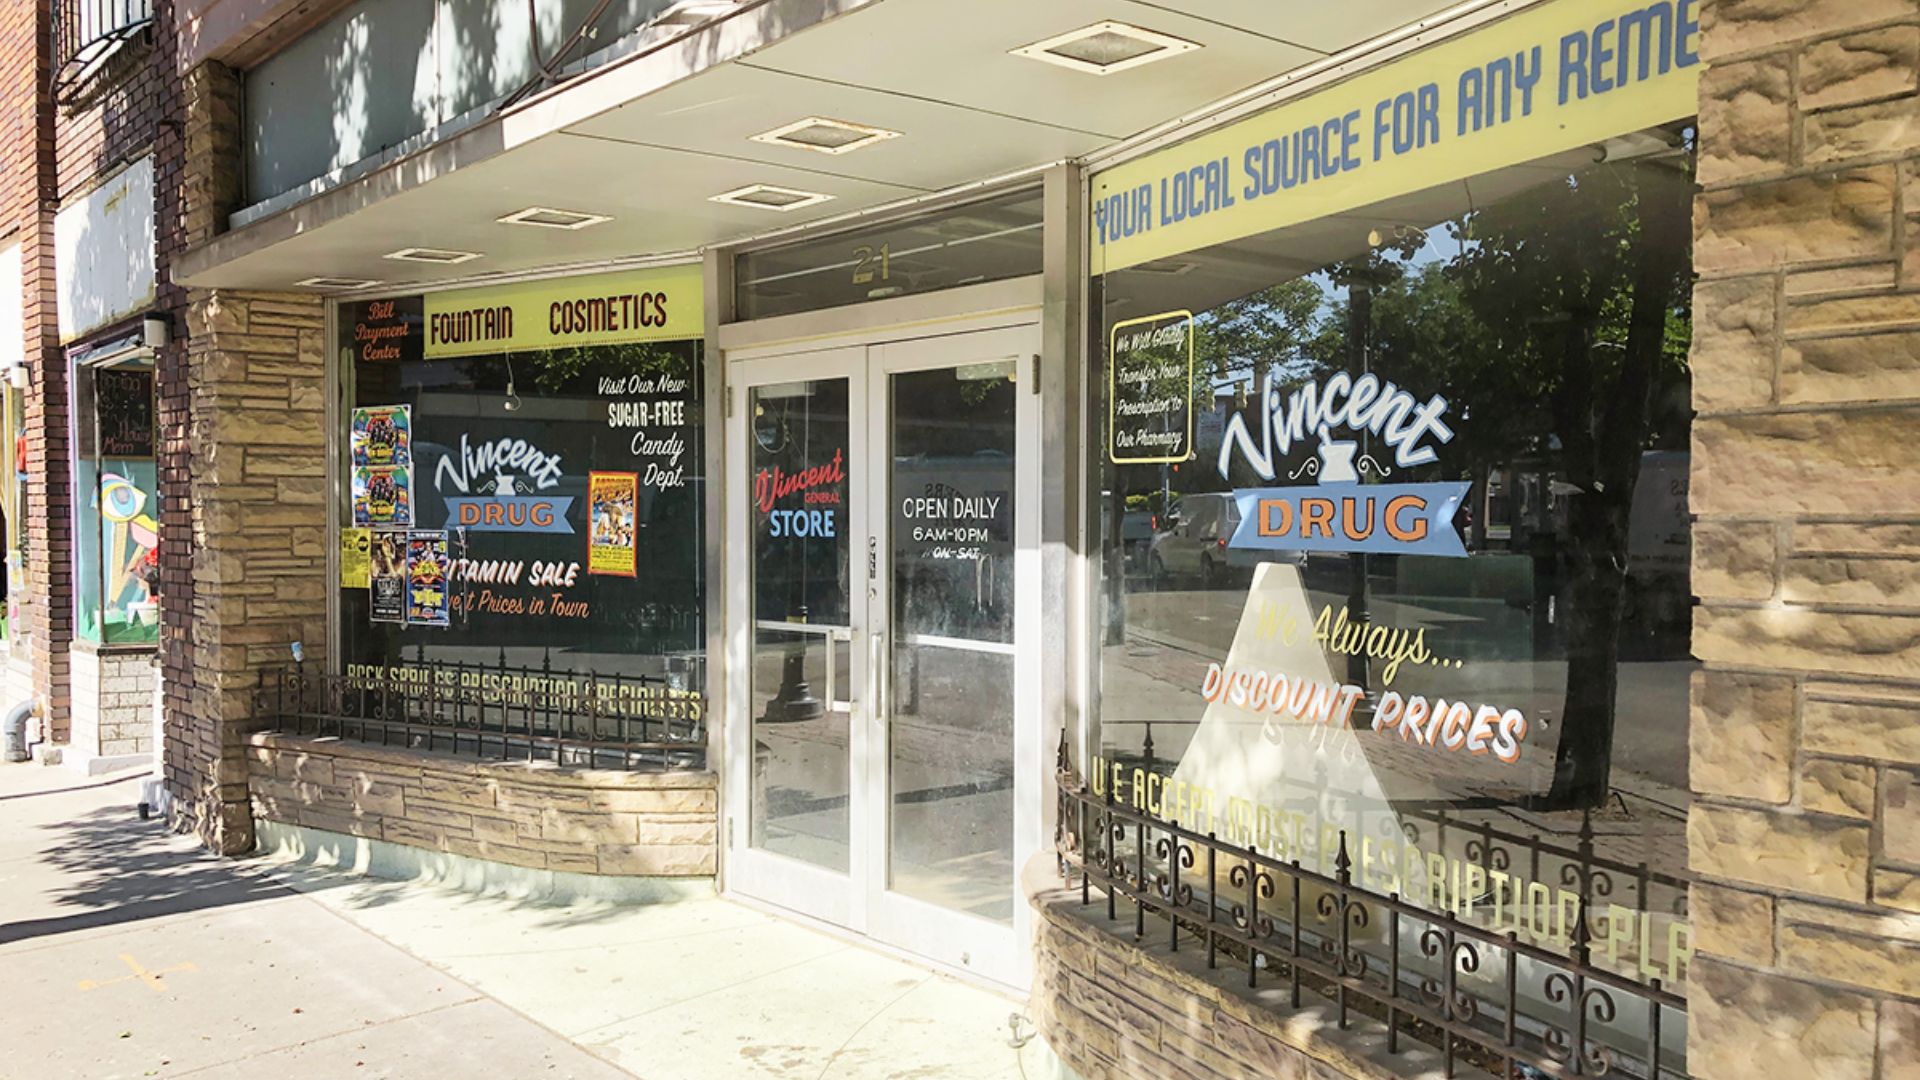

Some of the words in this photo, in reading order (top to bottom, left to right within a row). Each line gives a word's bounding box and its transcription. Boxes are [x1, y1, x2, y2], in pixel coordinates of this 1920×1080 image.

[1094, 184, 1152, 246] YOUR
[1160, 155, 1235, 227] LOCAL
[1243, 109, 1361, 200] SOURCE
[1373, 82, 1440, 161] FOR
[1457, 45, 1541, 137] ANY
[1558, 0, 1700, 106] REME
[852, 243, 890, 284] 21
[367, 301, 396, 320] Bill
[430, 305, 513, 345] FOUNTAIN
[549, 292, 668, 335] COSMETICS
[354, 322, 410, 345] Payment
[362, 342, 401, 360] Center
[598, 376, 627, 395] Visit
[628, 374, 655, 394] Our
[656, 373, 688, 393] New
[608, 400, 685, 428] SUGAR-FREE
[1117, 398, 1171, 419] Prescription
[1217, 369, 1456, 481] Vincent
[631, 430, 685, 467] Candy
[1116, 430, 1134, 448] Our
[1135, 428, 1184, 453] Pharmacy
[434, 432, 564, 494] Vincent
[644, 462, 685, 492] Dept.
[754, 448, 846, 513] Vincent
[458, 502, 555, 526] DRUG
[902, 497, 948, 519] OPEN
[952, 496, 1001, 519] DAILY
[1255, 494, 1430, 543] DRUG
[769, 508, 836, 538] STORE
[921, 545, 982, 560] ON-SAT
[447, 558, 524, 586] ITAMIN
[528, 560, 581, 588] SALE
[478, 589, 525, 615] Prices
[528, 596, 546, 616] in
[550, 593, 590, 619] Town
[1255, 600, 1298, 648] We
[1202, 662, 1365, 730] DISCOUNT
[1370, 690, 1528, 764] PRICES
[1132, 767, 1217, 834] ACCEPT
